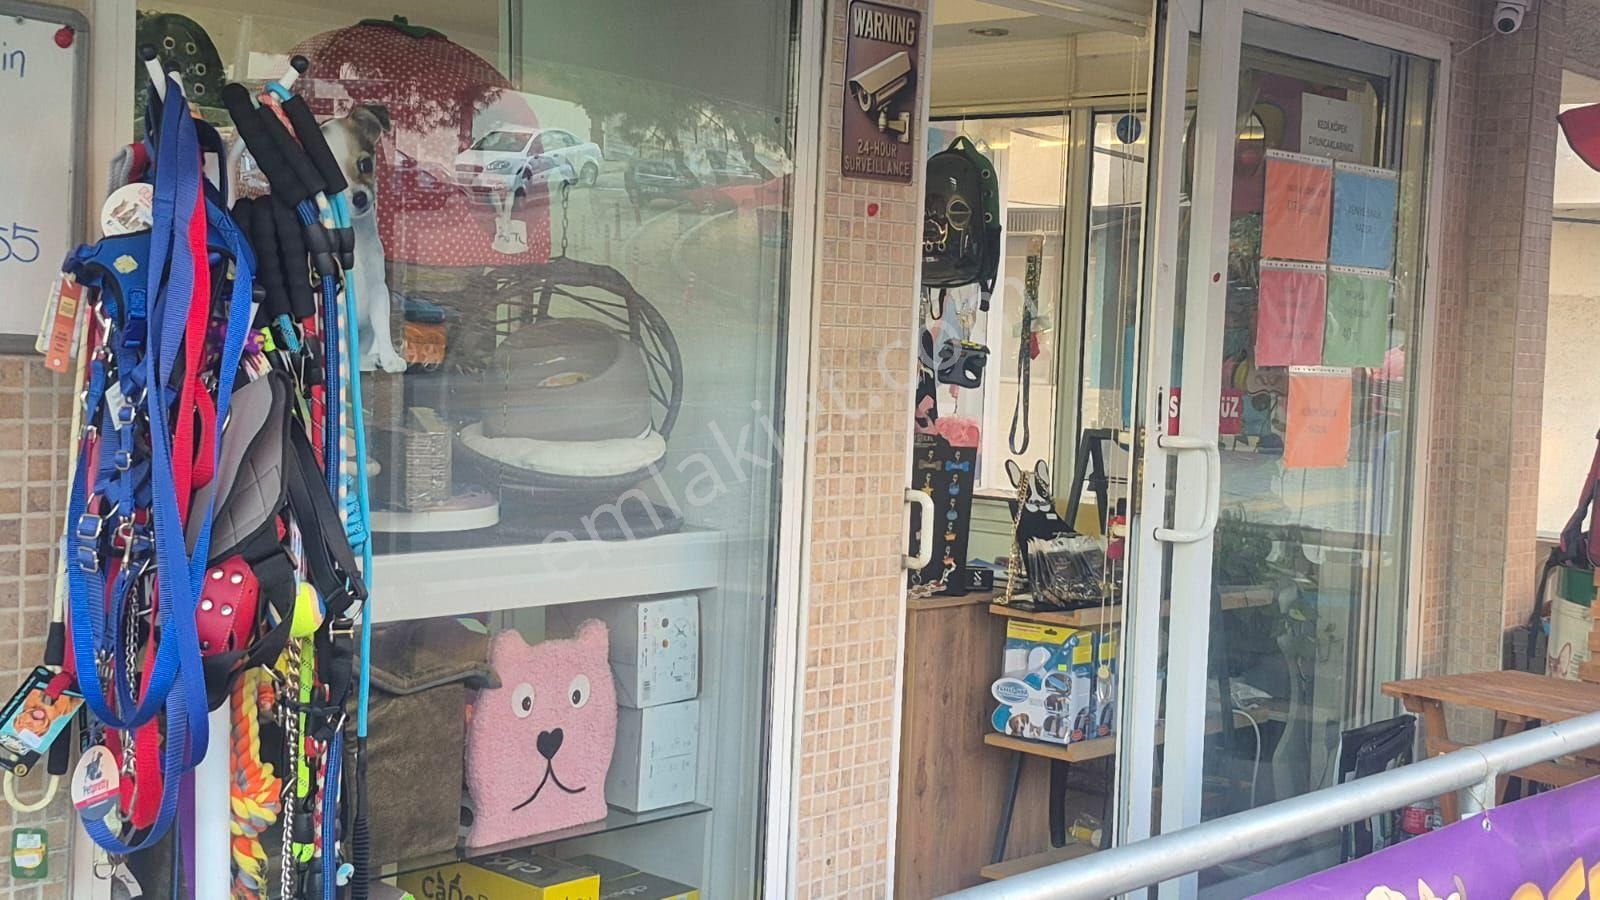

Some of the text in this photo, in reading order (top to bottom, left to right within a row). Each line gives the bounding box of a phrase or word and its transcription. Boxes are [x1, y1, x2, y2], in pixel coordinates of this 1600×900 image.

[853, 7, 916, 45] WARNING
[857, 138, 898, 158] 24-HOUR
[844, 154, 911, 177] SURVEILLANCE
